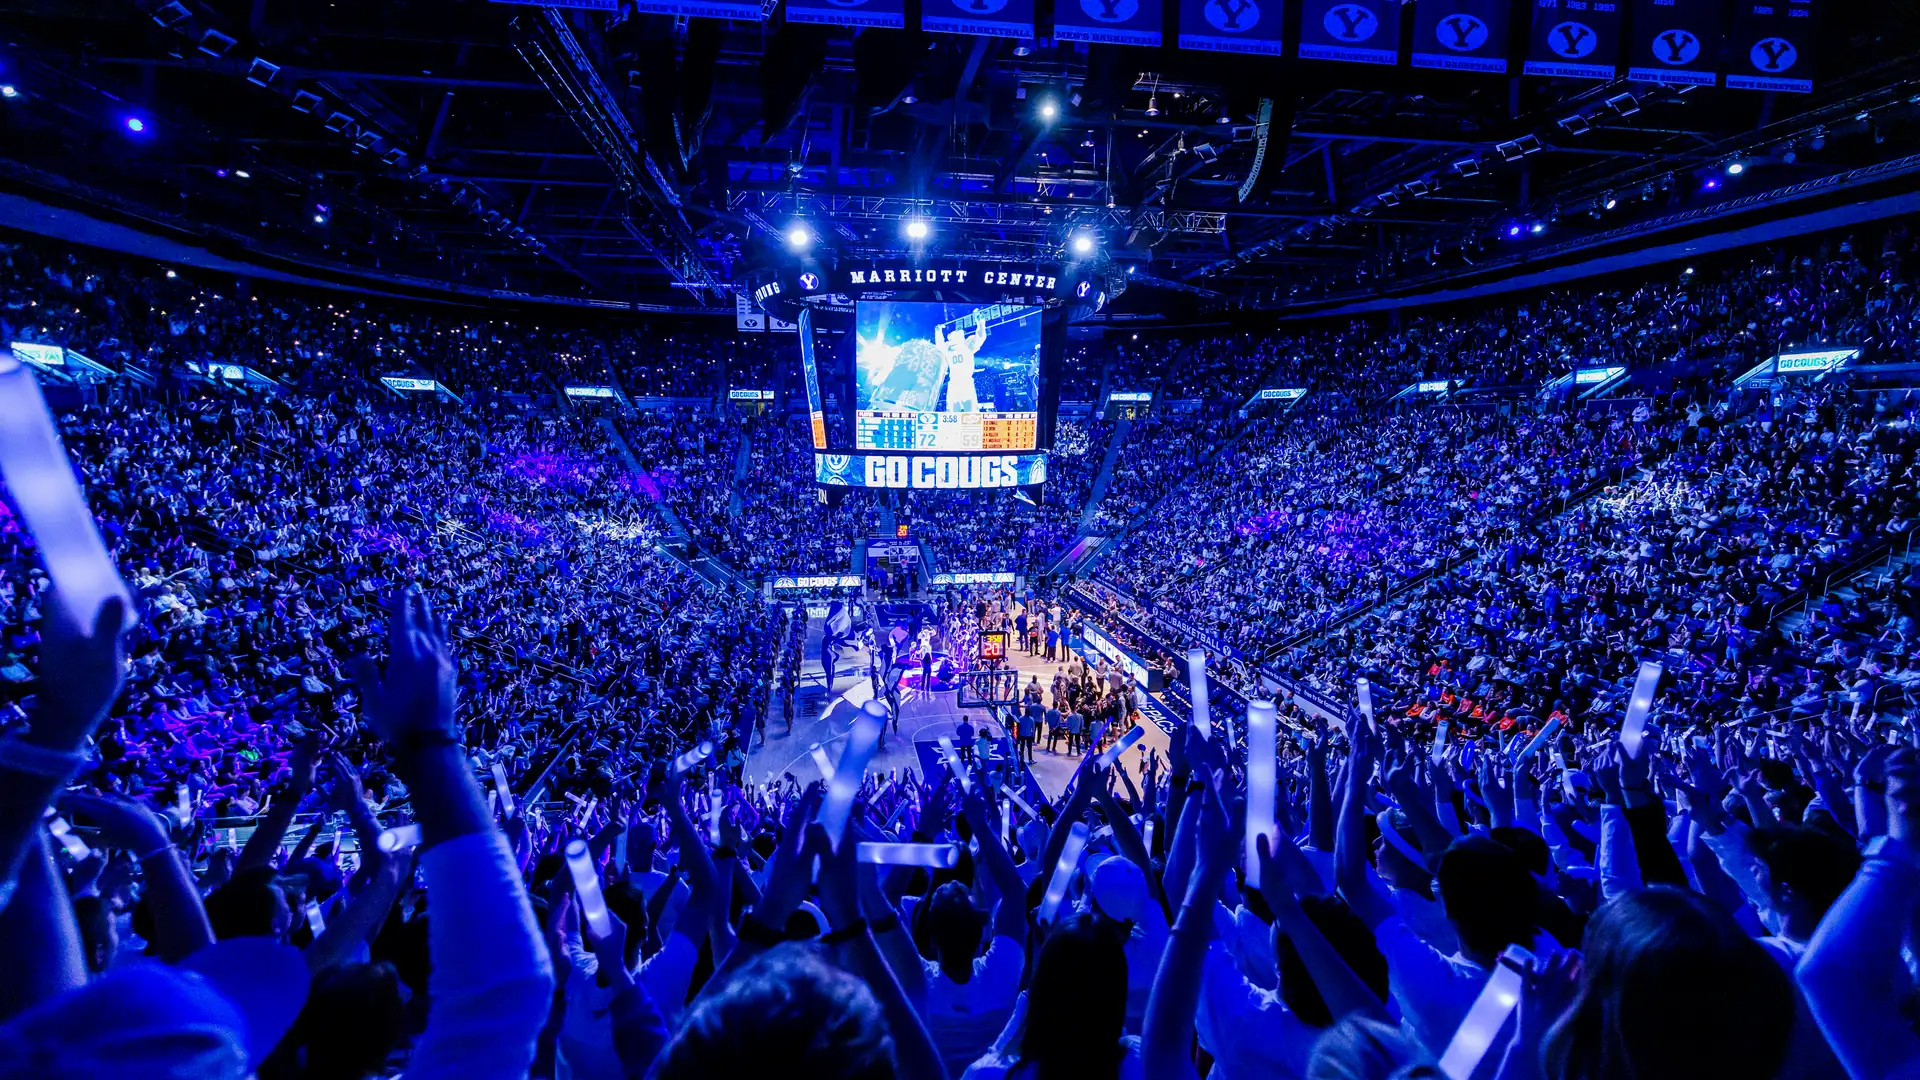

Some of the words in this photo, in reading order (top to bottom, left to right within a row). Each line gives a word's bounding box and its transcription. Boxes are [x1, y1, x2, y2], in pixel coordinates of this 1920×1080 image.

[1095, 0, 1125, 18] Y
[1215, 0, 1252, 28] Y
[1334, 8, 1369, 38] Y
[1447, 18, 1480, 47] Y
[1558, 25, 1588, 54] Y
[1661, 33, 1693, 61] Y
[1760, 42, 1789, 68] Y
[801, 274, 815, 289] Y
[850, 270, 967, 283] MARRIOTT
[984, 272, 1056, 288] CENTER
[1080, 281, 1091, 297] Y
[952, 354, 964, 364] 00
[1780, 359, 1793, 369] GO
[1794, 356, 1828, 368] COUGS
[943, 415, 958, 423] 3:58
[919, 434, 936, 447] 72
[963, 434, 979, 447] 59
[865, 456, 908, 488] GO
[912, 456, 1018, 488] COUGS
[798, 577, 809, 586] GO
[810, 577, 838, 587] COUGS
[955, 573, 966, 583] GO
[967, 573, 992, 583] COUGS
[984, 643, 1000, 656] 20
